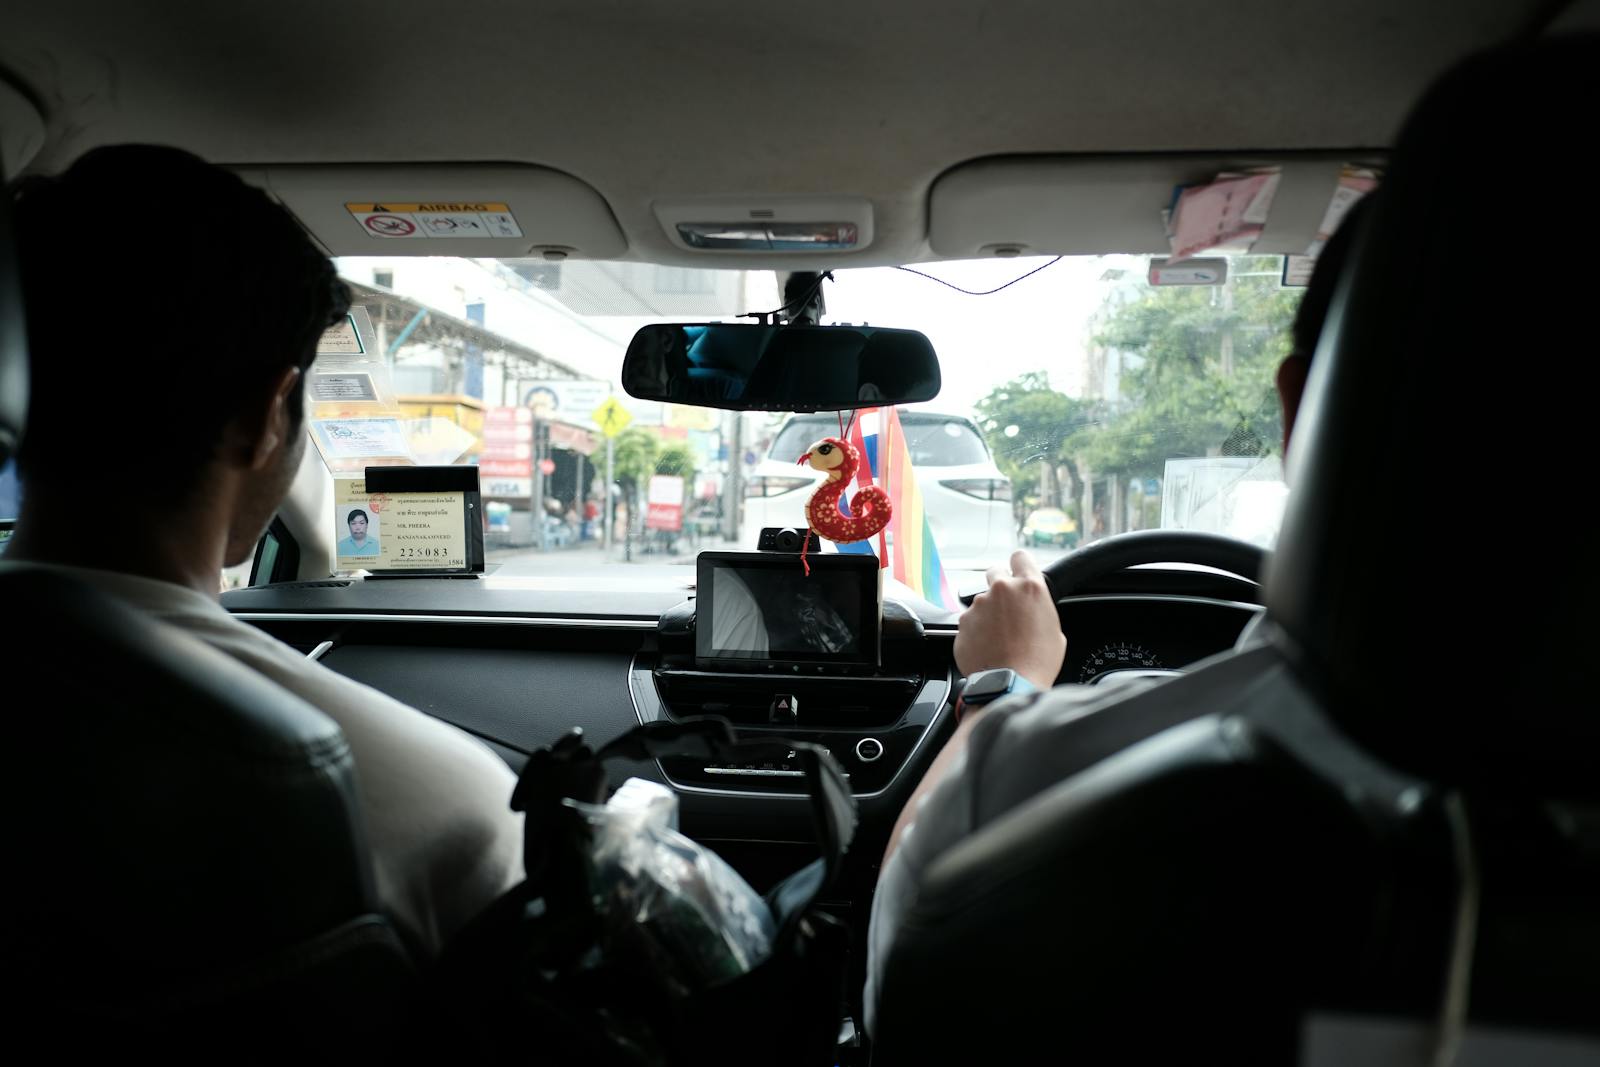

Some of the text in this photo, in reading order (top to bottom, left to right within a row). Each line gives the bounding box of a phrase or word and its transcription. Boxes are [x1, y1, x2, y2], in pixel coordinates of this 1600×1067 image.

[418, 203, 489, 212] AIRBAG
[488, 482, 520, 495] VISA
[400, 548, 448, 557] 225083
